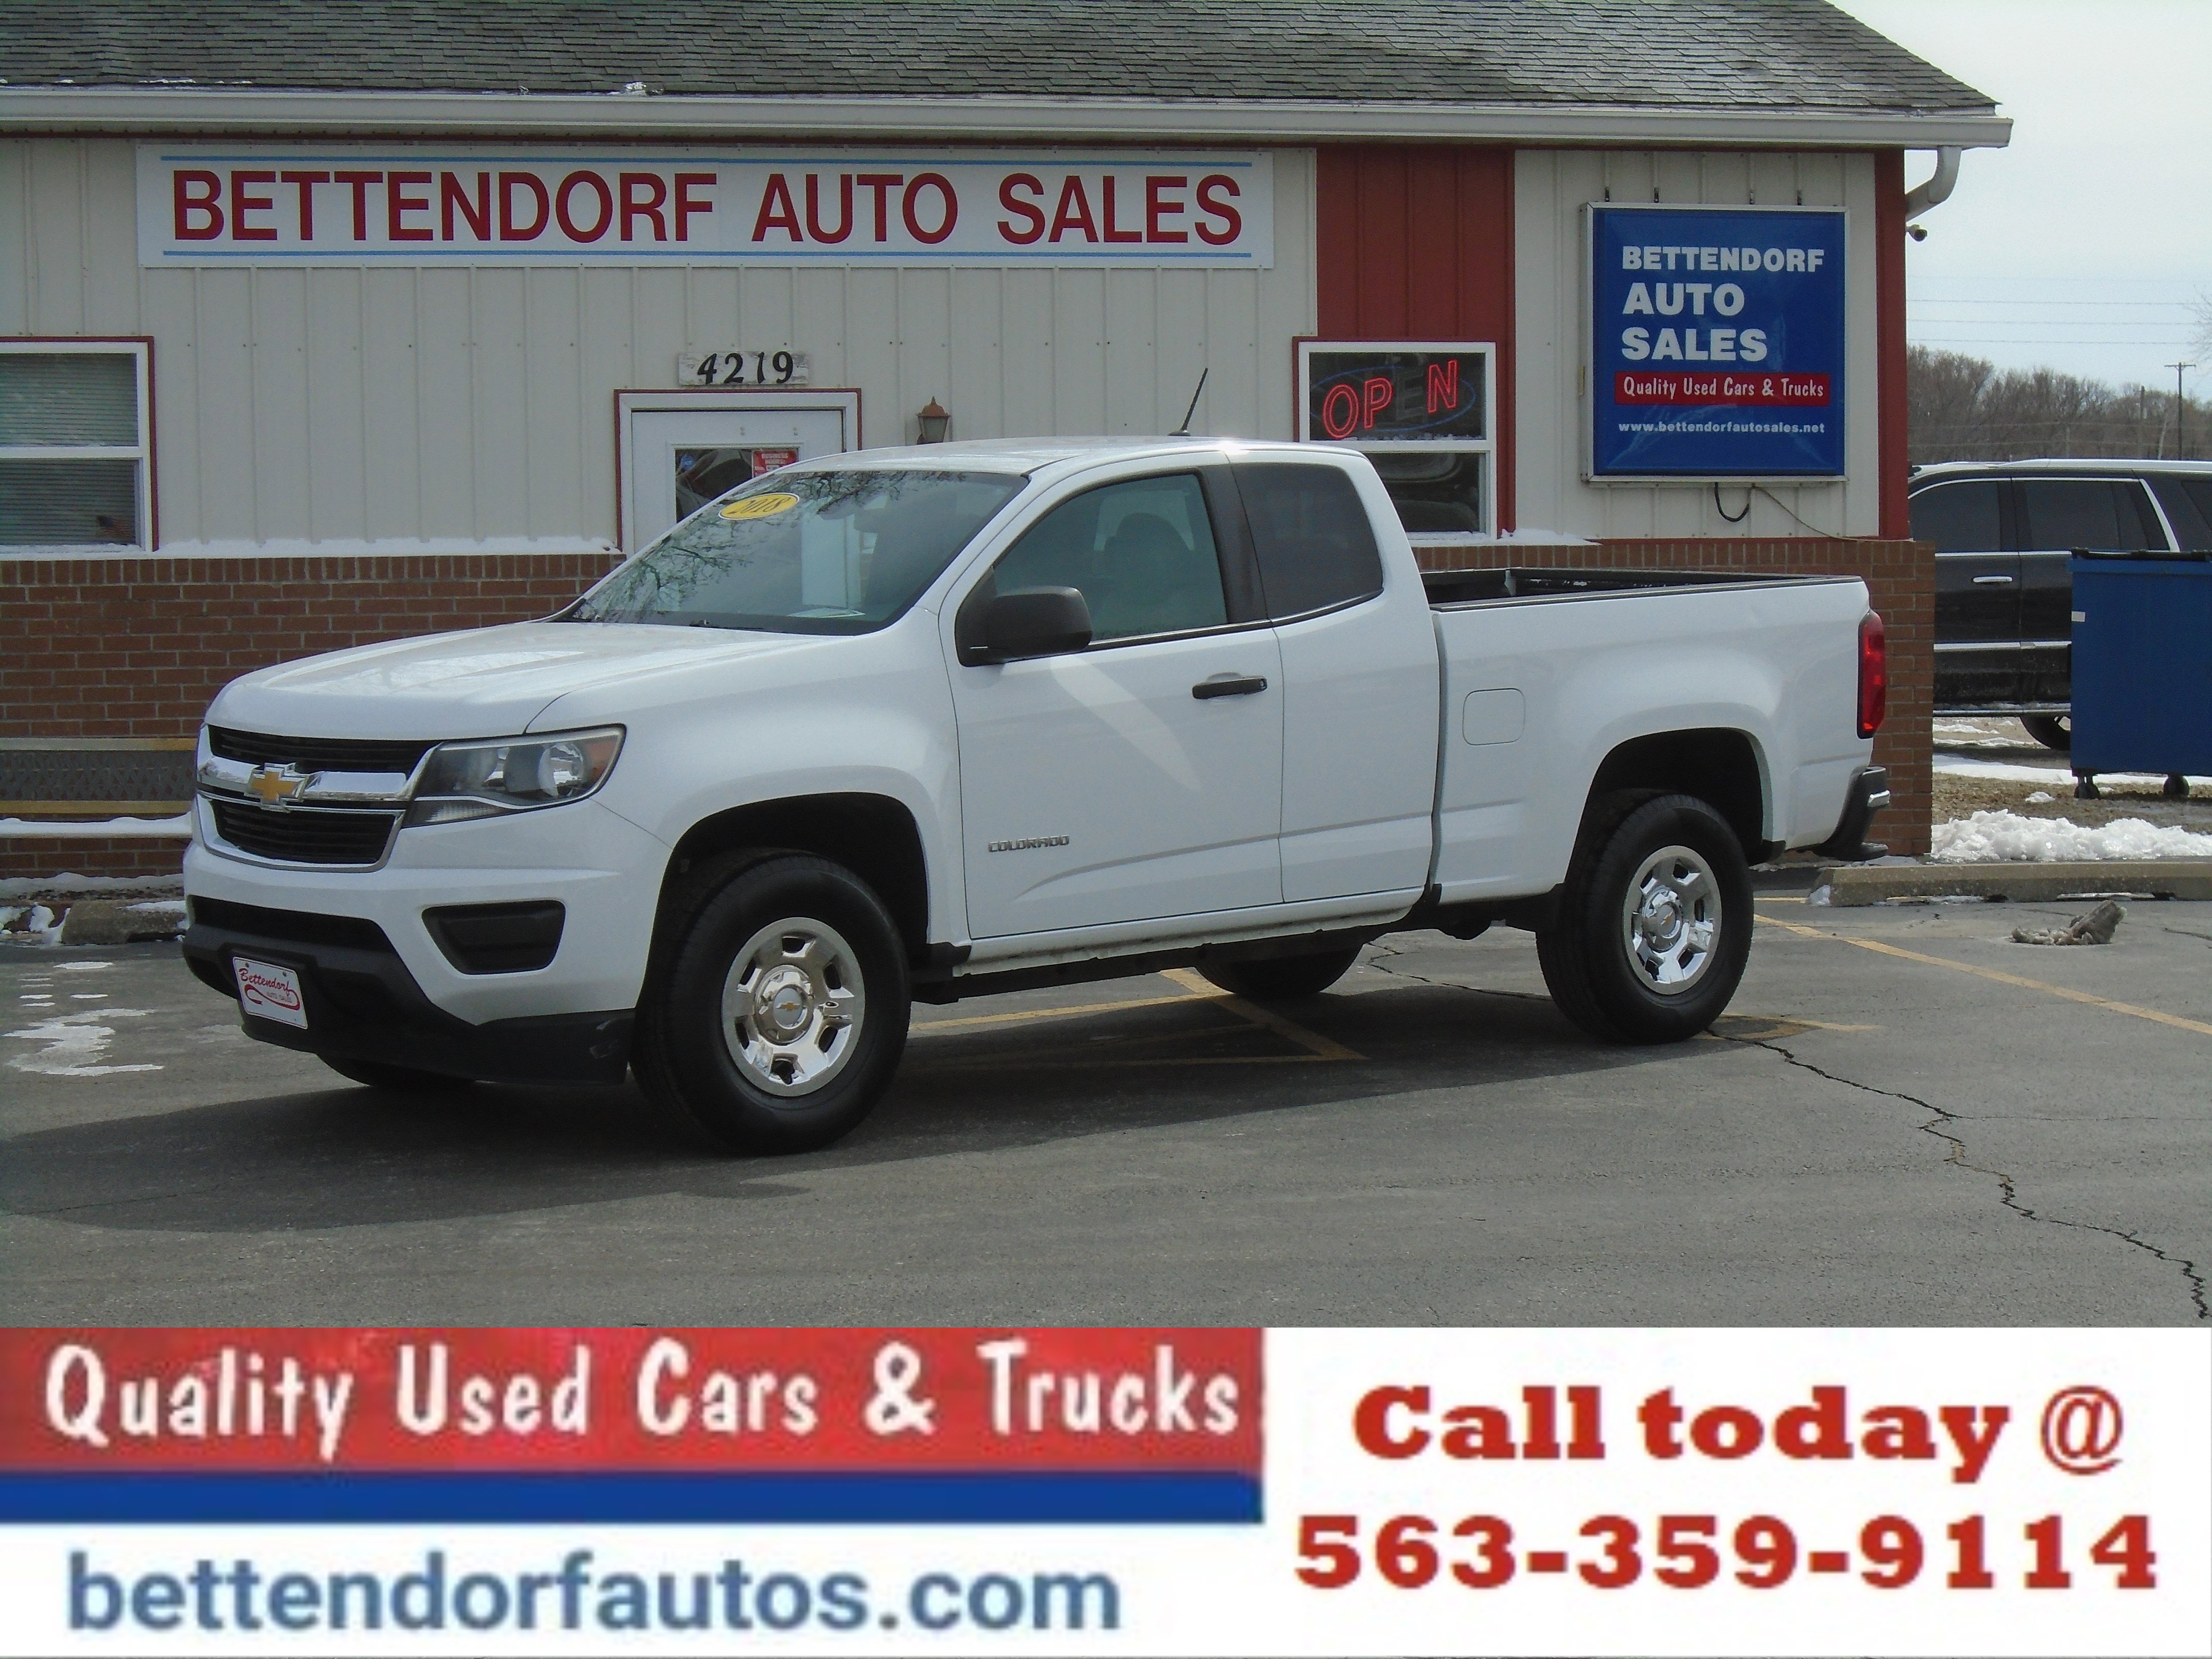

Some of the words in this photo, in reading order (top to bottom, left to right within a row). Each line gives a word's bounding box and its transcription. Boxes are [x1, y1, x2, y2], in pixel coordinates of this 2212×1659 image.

[173, 170, 717, 243] BETTENDORF
[752, 174, 957, 243] AUTO
[998, 175, 1241, 244] SALES
[1622, 246, 1825, 273] BETTENDORF
[1623, 282, 1745, 316] AUTO
[1622, 327, 1768, 362] SALES
[697, 351, 794, 384] 4219
[1623, 376, 1677, 400] Quality
[1683, 377, 1717, 396] Used
[1723, 377, 1755, 396] Cars
[1762, 378, 1774, 396] &
[1781, 378, 1824, 397] Trucks
[1618, 421, 1825, 433] www.bettendorfautosales.net
[726, 497, 791, 515] 2018
[988, 835, 1070, 852] COLORADO
[239, 967, 292, 997] Bettendorf
